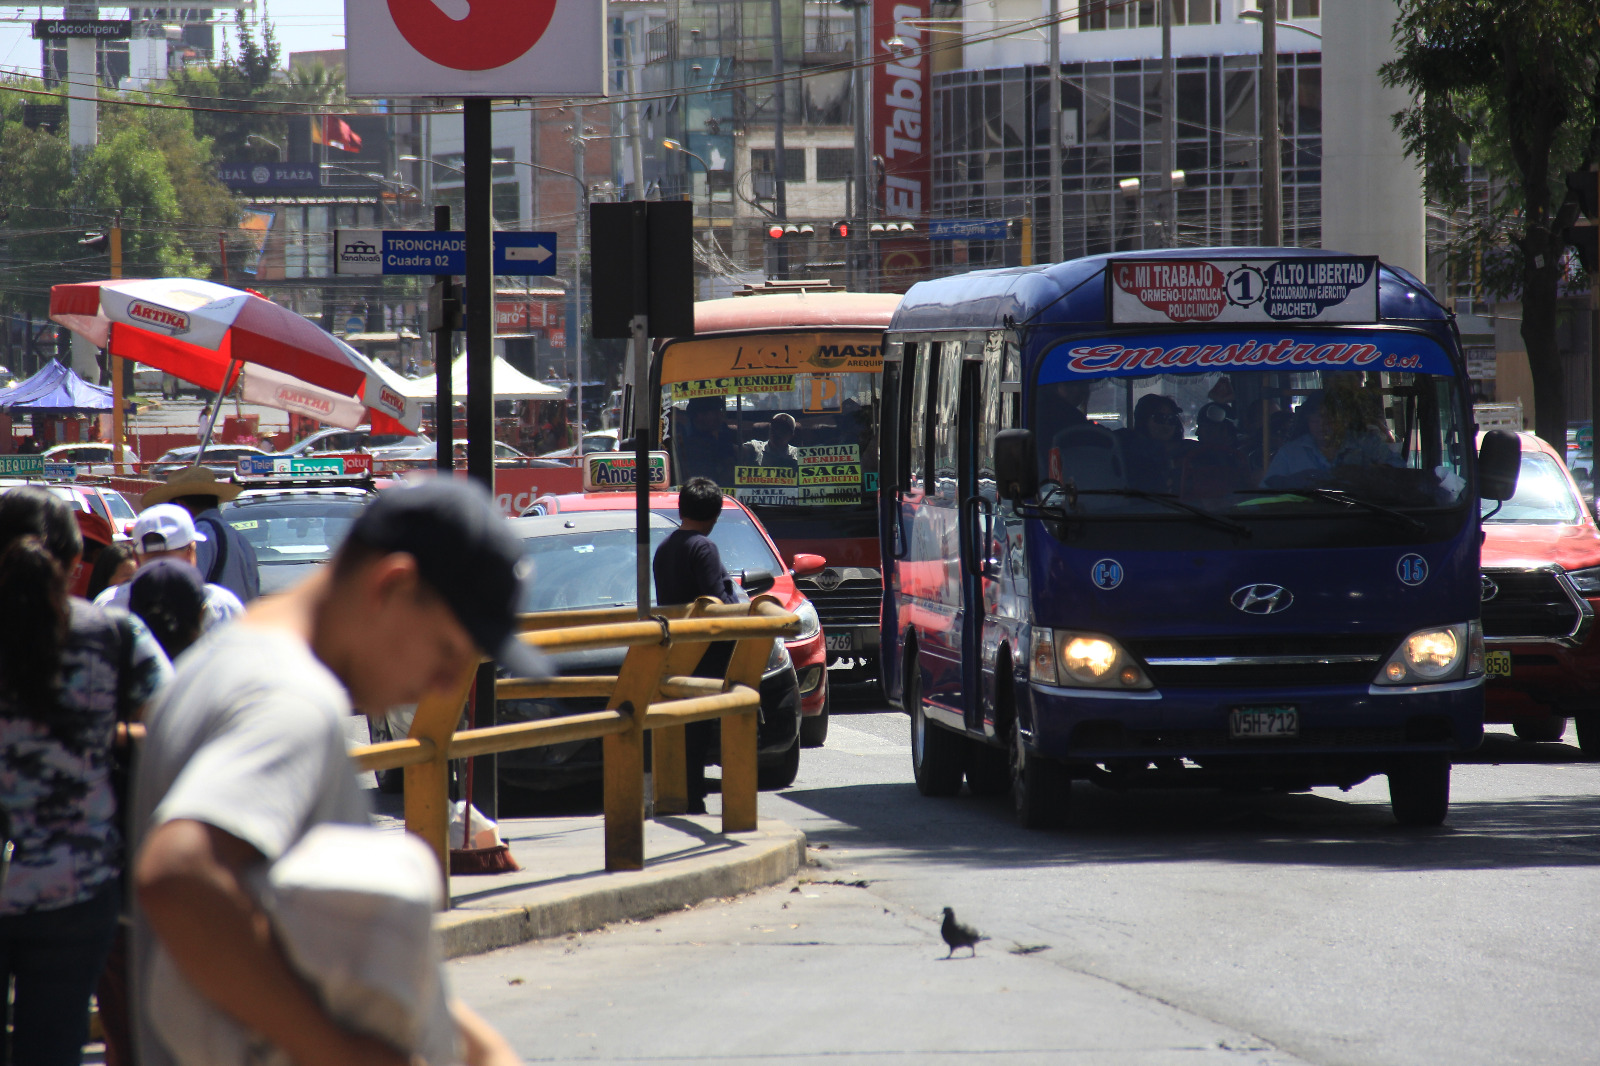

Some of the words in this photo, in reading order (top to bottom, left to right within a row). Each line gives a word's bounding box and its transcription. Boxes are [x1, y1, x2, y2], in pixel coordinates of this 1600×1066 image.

[881, 5, 922, 159] Tablón
[217, 169, 248, 180] REAL
[276, 169, 314, 180] PLAZA
[886, 176, 922, 219] El
[388, 255, 431, 266] Cuadra
[435, 255, 449, 266] 02
[1120, 266, 1133, 288] C.
[1135, 266, 1151, 287] MI
[1154, 265, 1213, 287] TRABAJO
[1273, 264, 1304, 284] ALTO
[1307, 263, 1365, 284] LIBERTAD
[1233, 271, 1254, 300] 1
[1317, 286, 1347, 299] EJERCITO
[131, 303, 185, 329] ARTIKA
[1169, 303, 1219, 317] POLICLINICO
[1270, 302, 1318, 316] APACHETA
[495, 310, 519, 324] laro
[1067, 338, 1382, 373] Emarsistran
[847, 359, 883, 367] AREQUIP
[734, 374, 794, 387] KENNEDY
[737, 384, 794, 393] ESCOMEL
[809, 378, 837, 411] P
[381, 389, 404, 412] ARTIKA
[811, 446, 858, 456] SOCIAL
[0, 459, 43, 473] REQUIPA
[342, 458, 370, 471] gatur
[803, 455, 855, 464] MENDEL
[294, 463, 340, 476] Texas
[737, 467, 796, 479] FILTRO
[801, 465, 858, 477] SAGA
[813, 475, 859, 484] EJERCITO
[751, 488, 786, 496] MALL
[1095, 563, 1120, 586] C-9
[1402, 558, 1424, 581] 15
[1486, 657, 1510, 673] 858
